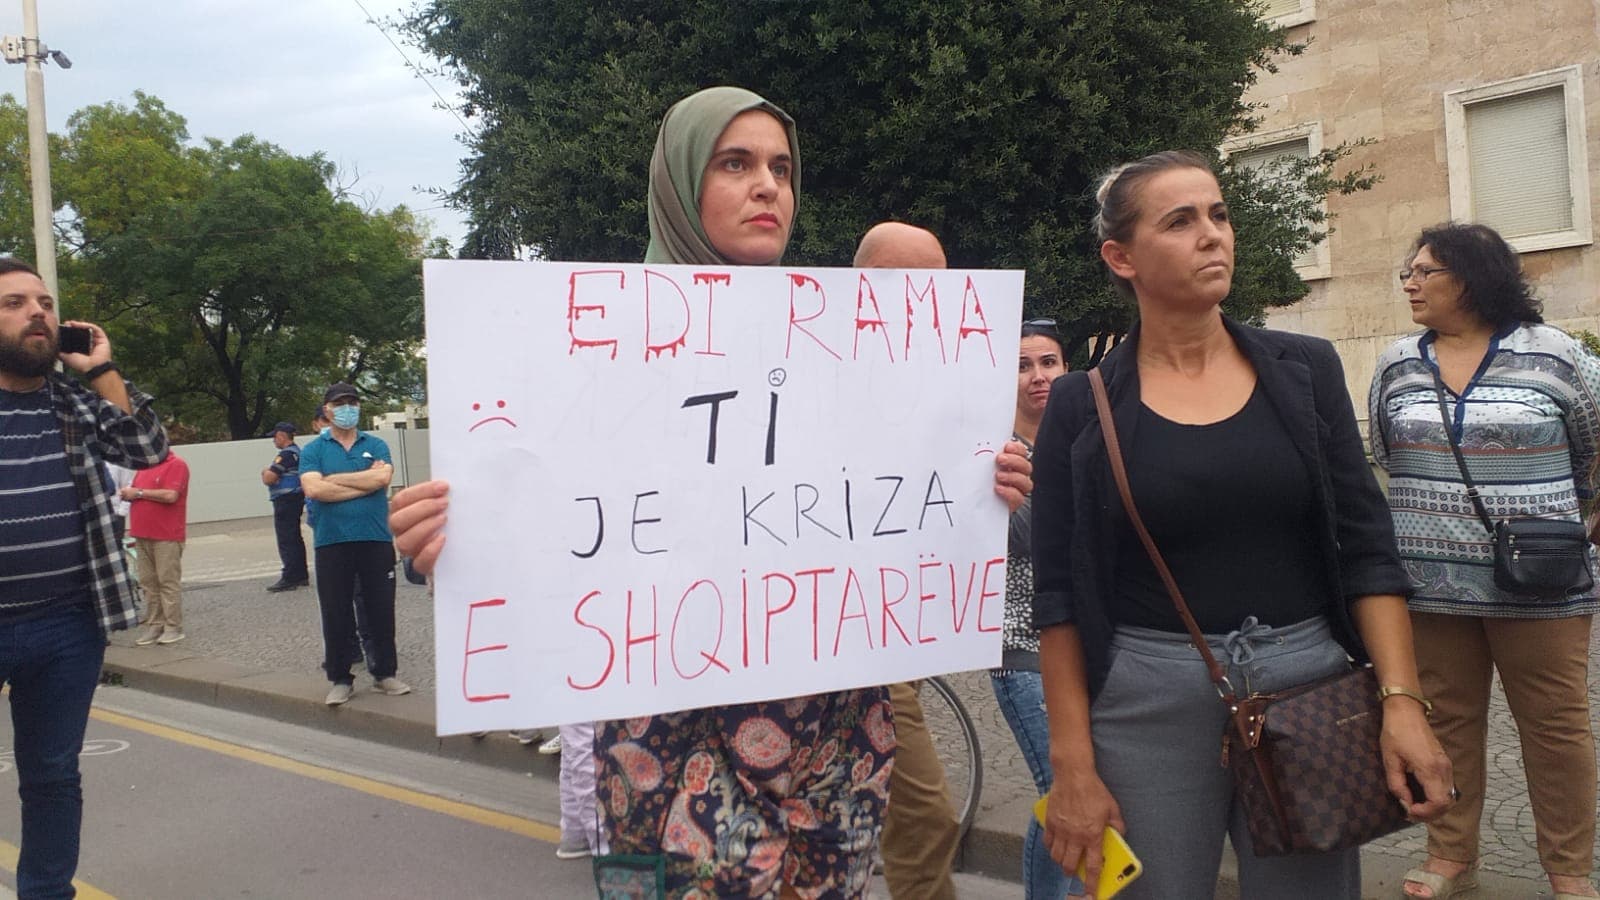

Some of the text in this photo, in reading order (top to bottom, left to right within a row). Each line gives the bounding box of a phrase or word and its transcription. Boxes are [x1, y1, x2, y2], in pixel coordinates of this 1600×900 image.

[568, 269, 995, 367] EDI RAMA
[571, 491, 667, 558] JE
[463, 599, 510, 702] E
